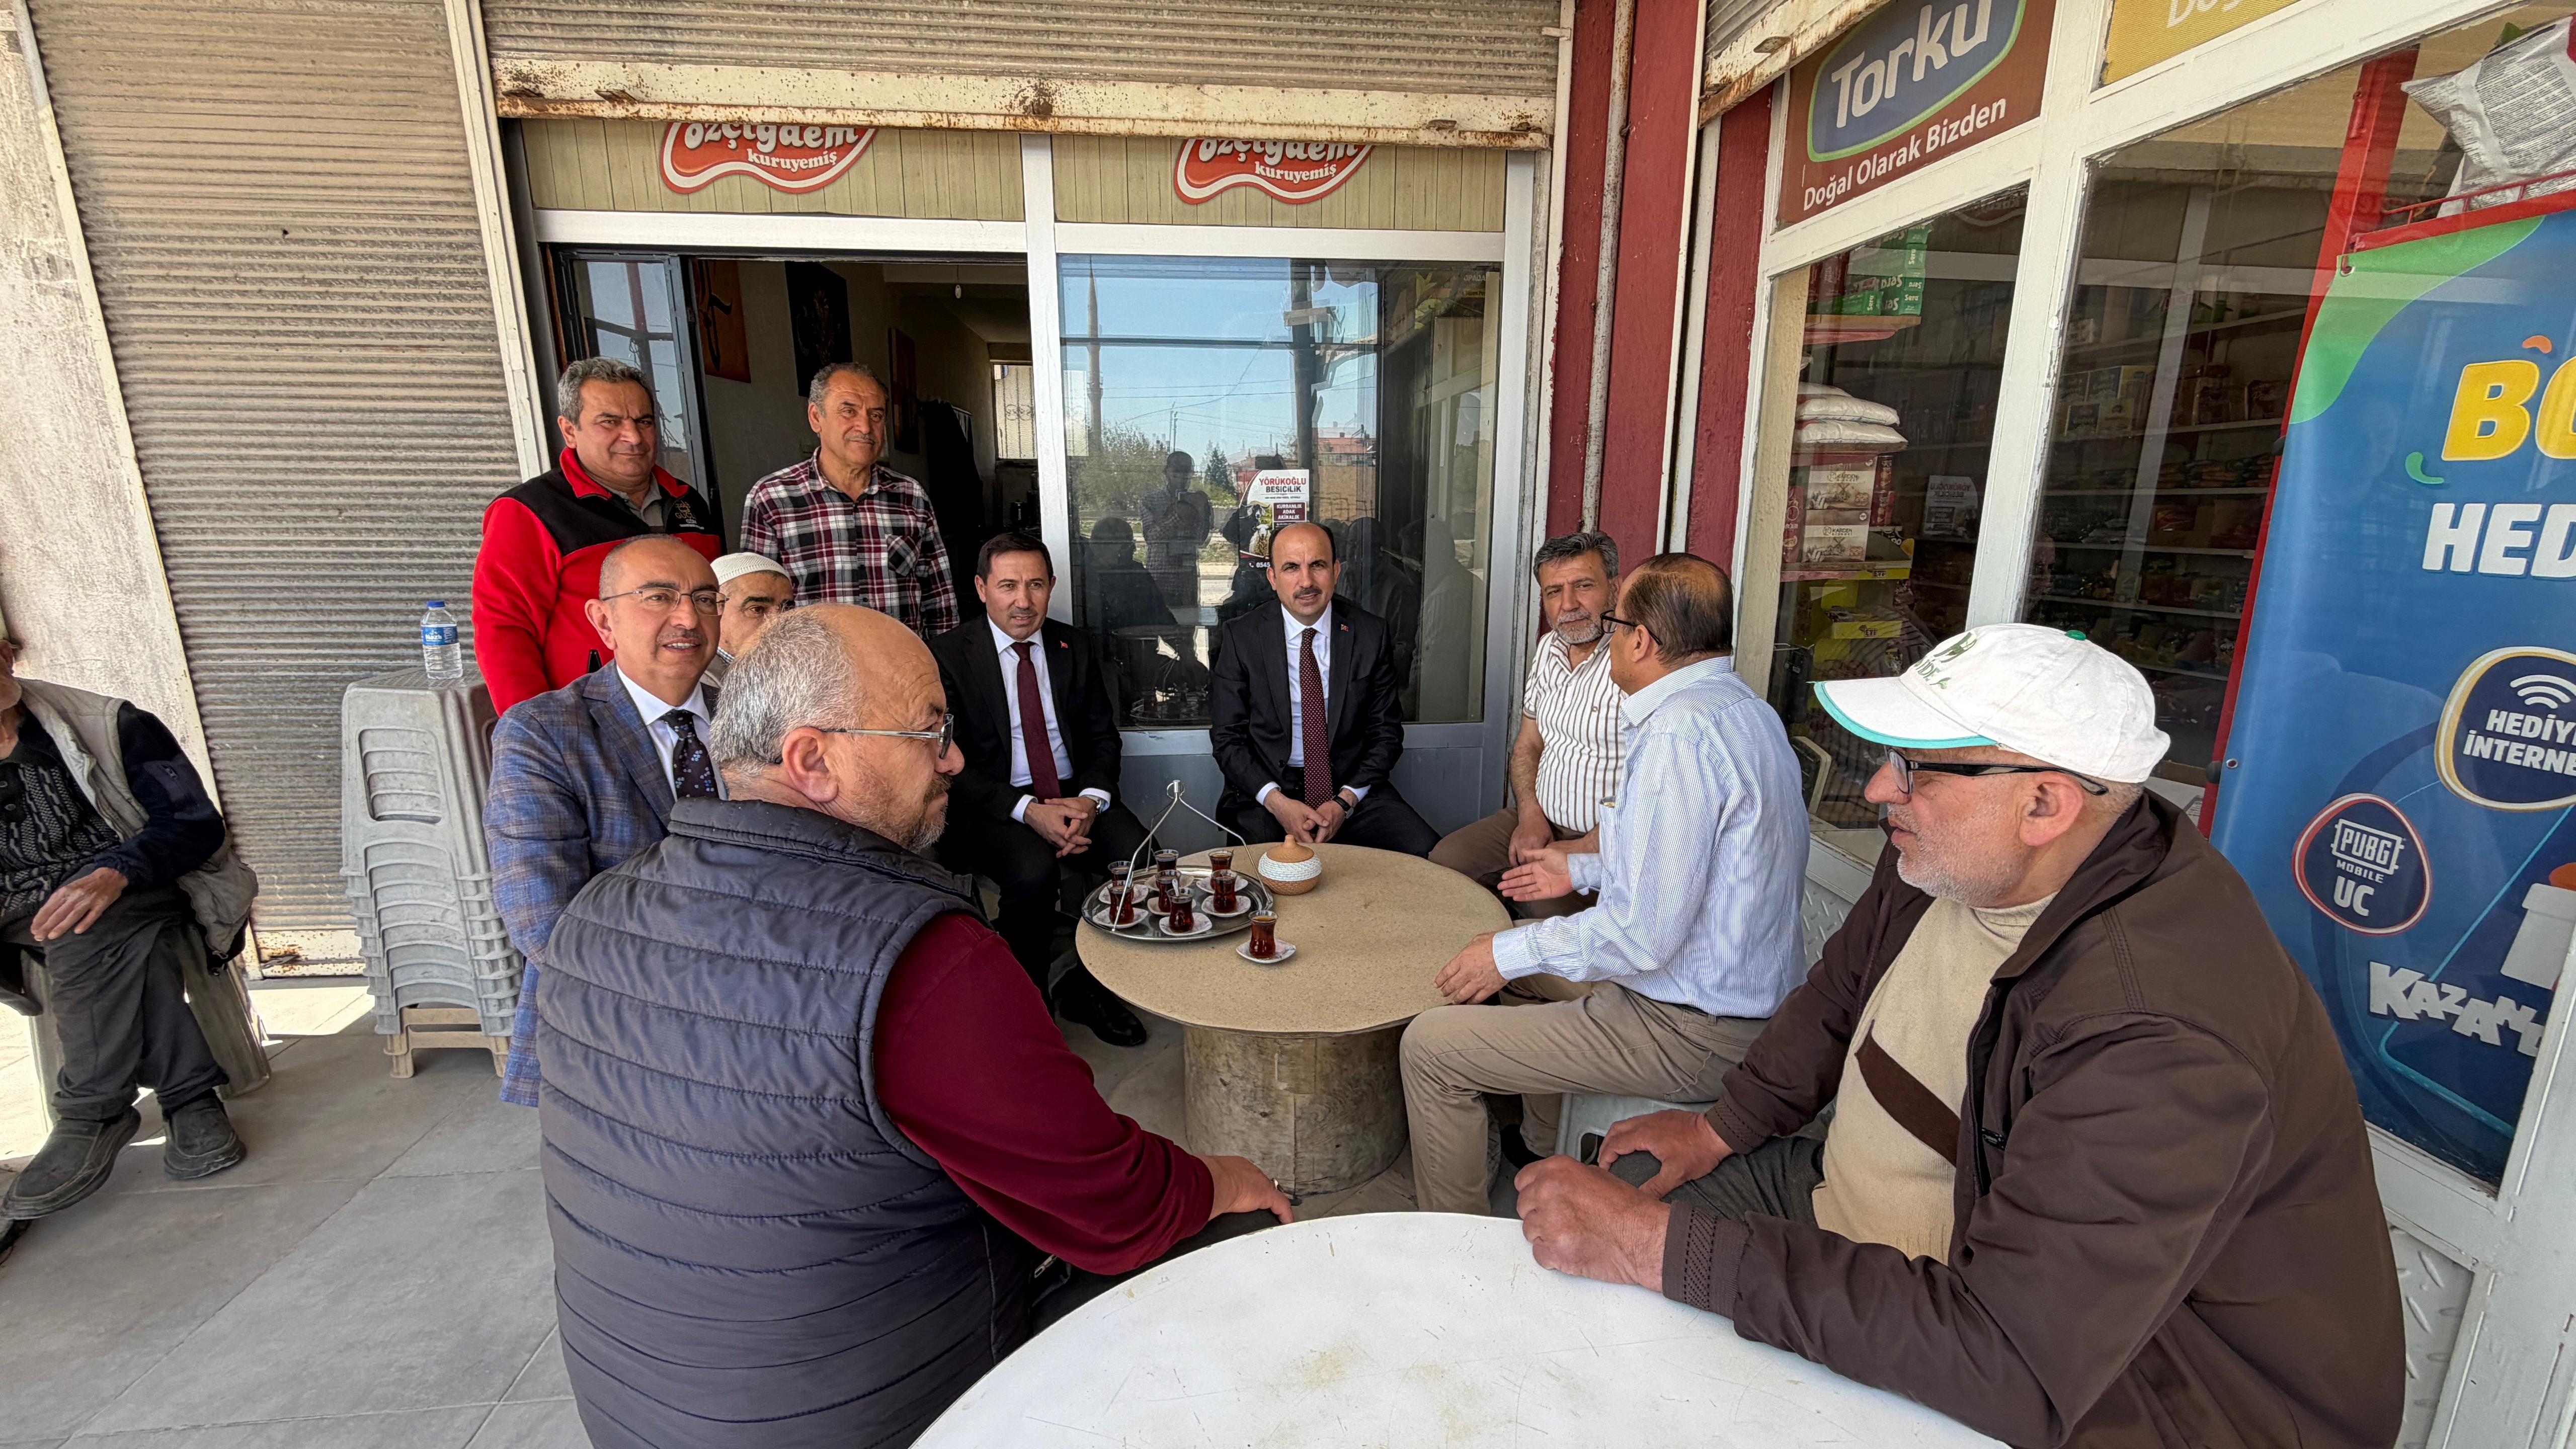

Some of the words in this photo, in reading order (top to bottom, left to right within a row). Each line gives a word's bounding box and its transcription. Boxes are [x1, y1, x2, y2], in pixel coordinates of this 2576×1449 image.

[1831, 0, 1991, 128] Torku
[747, 148, 838, 173] kuruyemiş
[1255, 161, 1337, 184] kuruyemiş
[1804, 167, 1852, 211] Doğal
[1857, 134, 1922, 185] Olarak
[1925, 98, 2006, 153] Bizden
[1259, 476, 1307, 486] YÖRÜKOĞLU
[2486, 709, 2576, 746] HEDİY
[2340, 828, 2392, 865] PUBG
[2336, 859, 2384, 883] MOBILE
[2333, 875, 2375, 917] UC
